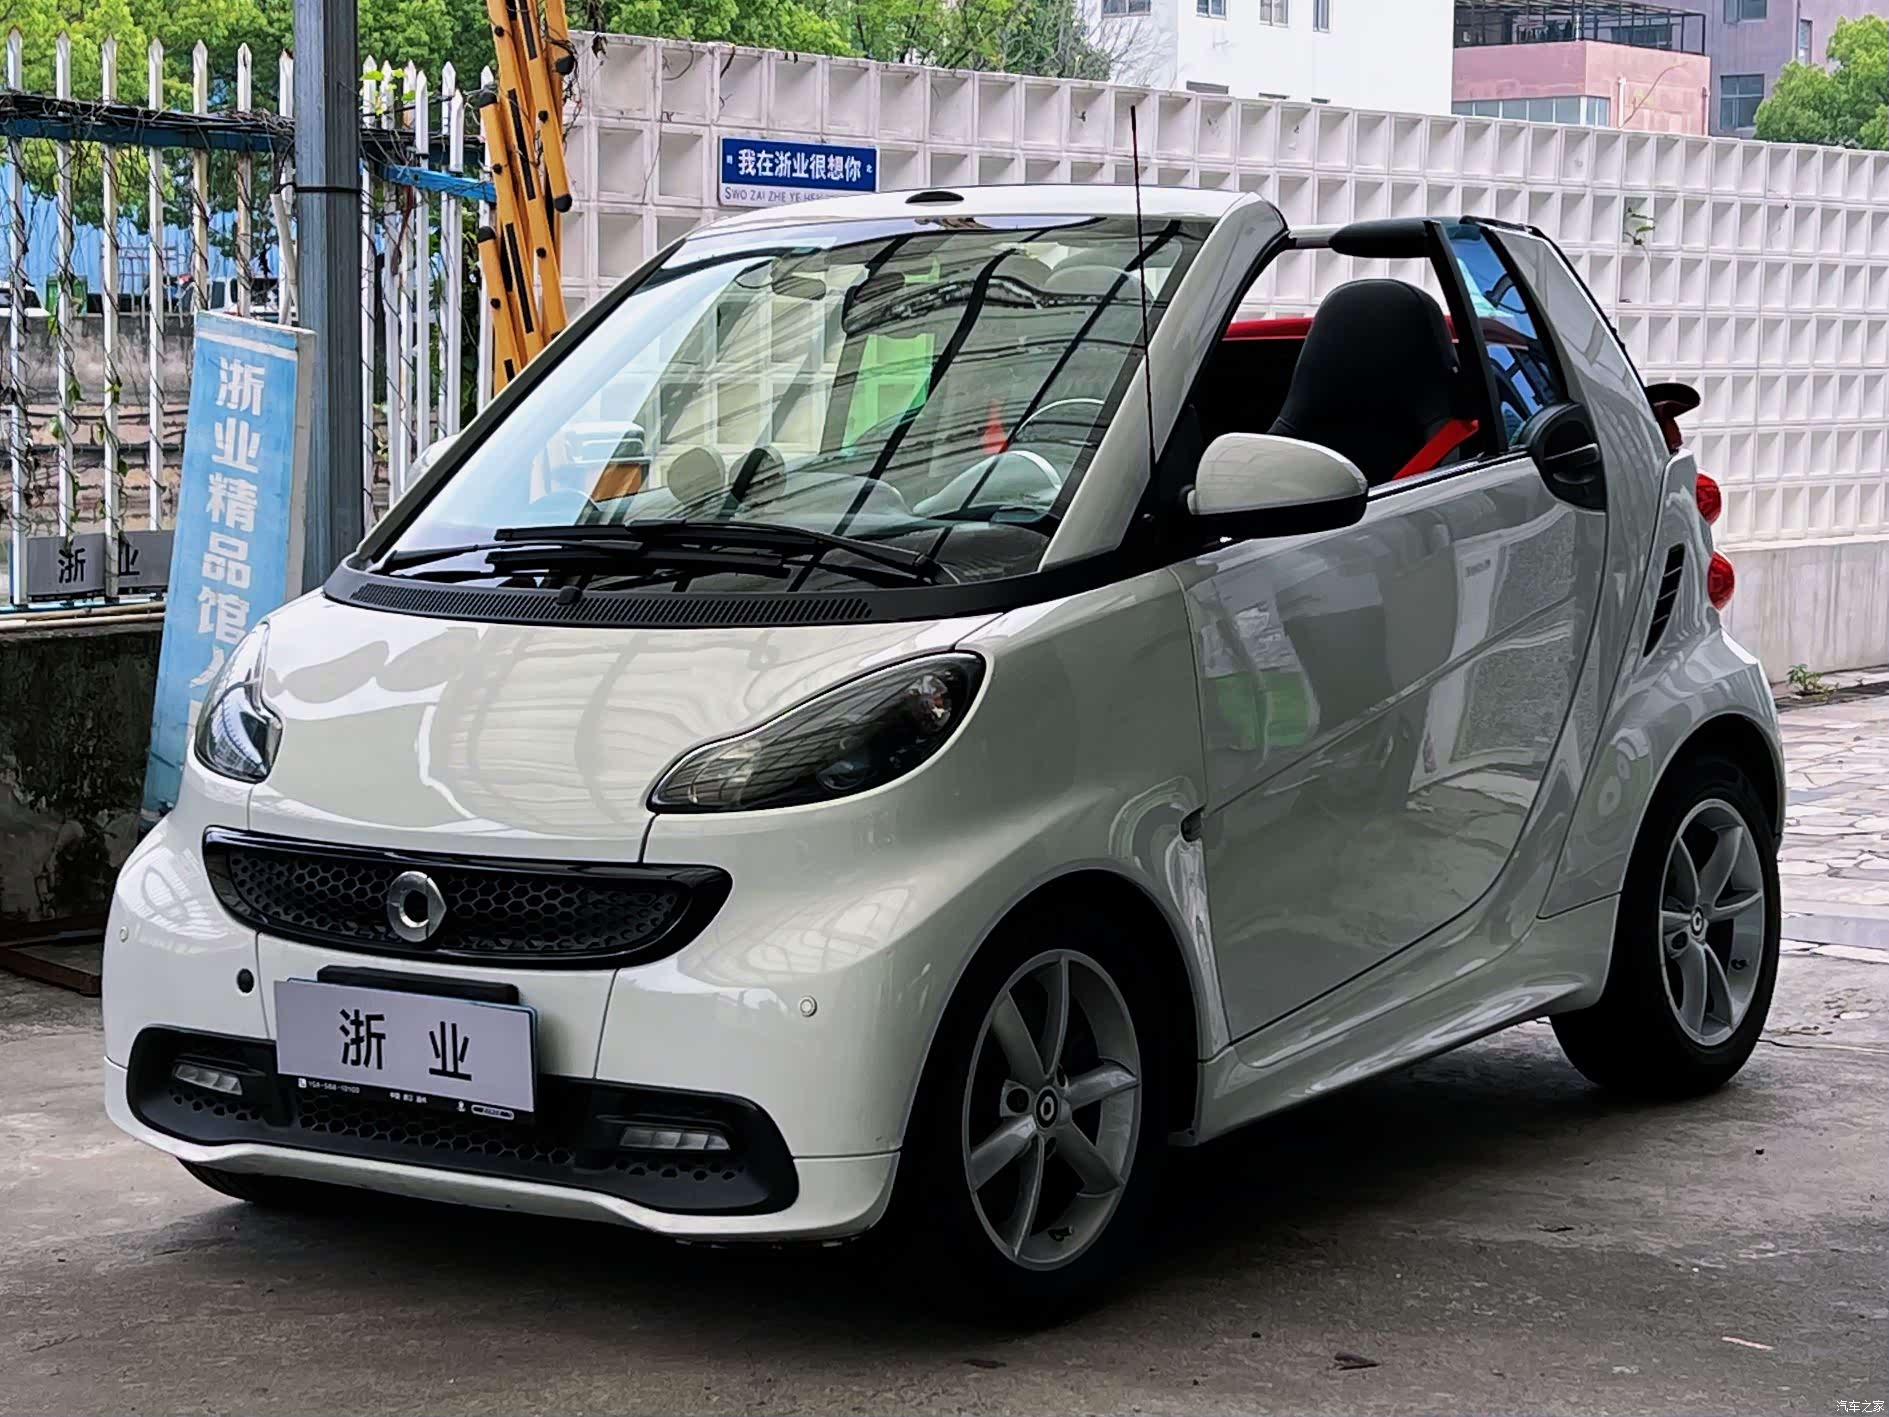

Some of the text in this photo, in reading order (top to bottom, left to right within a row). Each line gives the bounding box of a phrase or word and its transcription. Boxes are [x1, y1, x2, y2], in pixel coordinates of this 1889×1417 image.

[738, 149, 862, 182] 我在浙业很想你
[750, 189, 766, 201] ZAI
[768, 190, 786, 202] ZHE
